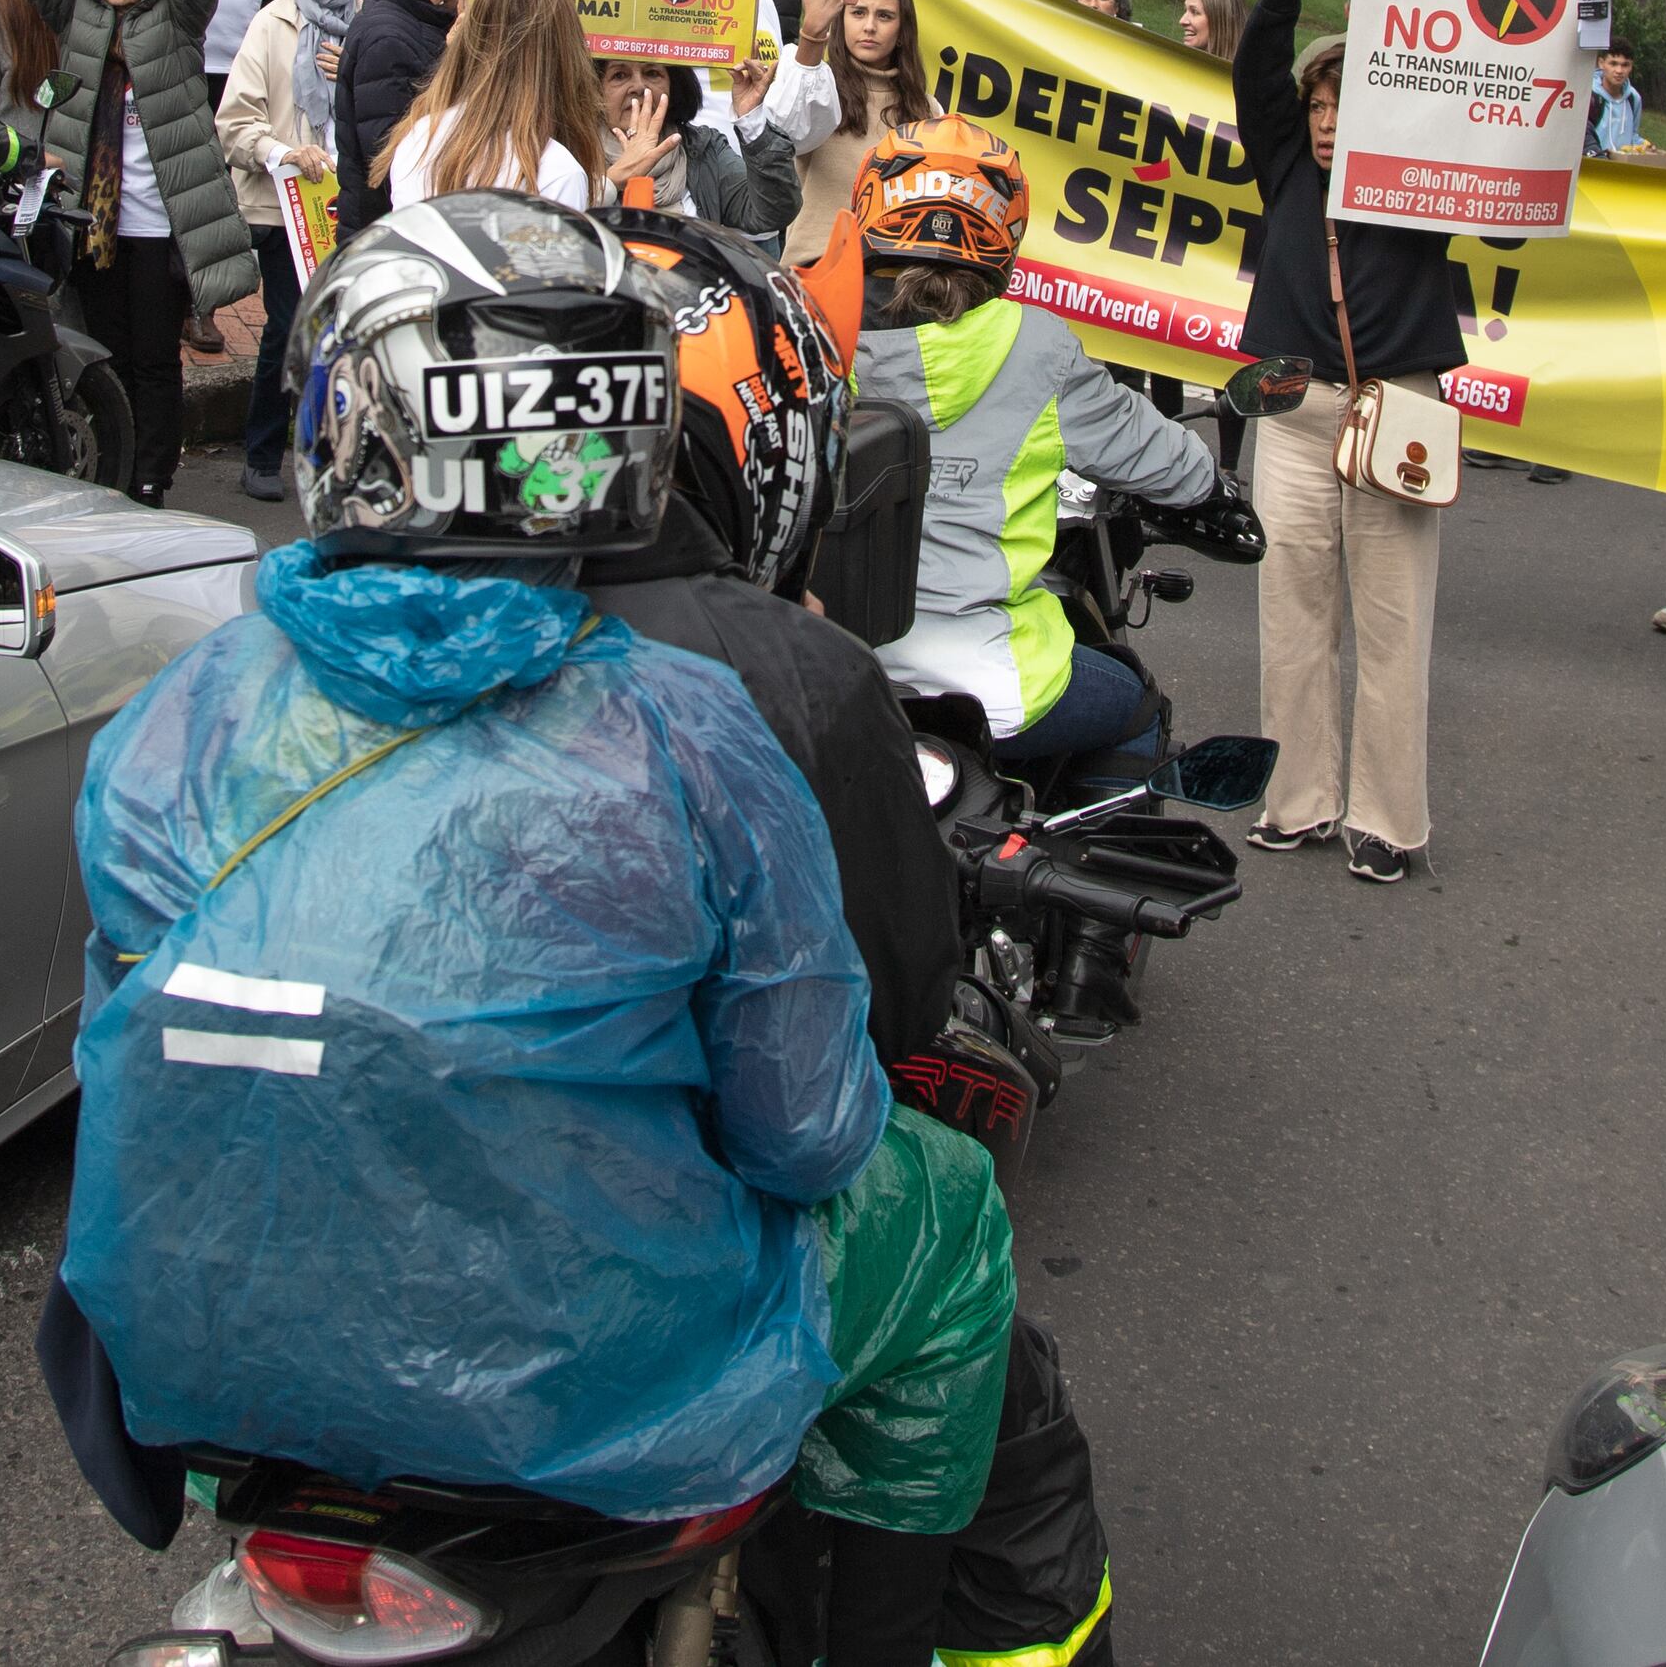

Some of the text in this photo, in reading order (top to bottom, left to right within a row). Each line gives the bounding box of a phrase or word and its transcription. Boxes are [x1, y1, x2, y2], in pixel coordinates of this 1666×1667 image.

[648, 7, 719, 18] AL TRANSMILENIO/
[648, 14, 719, 26] CORREDOR VERDE
[691, 25, 719, 36] CRA.
[1383, 4, 1462, 54] NO
[1369, 50, 1536, 83] AL TRANSMILENIO/
[1367, 70, 1532, 102] CORREDOR VERDE
[1468, 101, 1530, 128] CRA.
[1400, 166, 1522, 198] @NoTM7verde
[883, 170, 1010, 227] HJD47E
[1006, 268, 1161, 331] @NoTM7verde
[1454, 375, 1512, 414] 5653
[735, 380, 763, 426] NEVER
[749, 374, 784, 451] RIDE FAST
